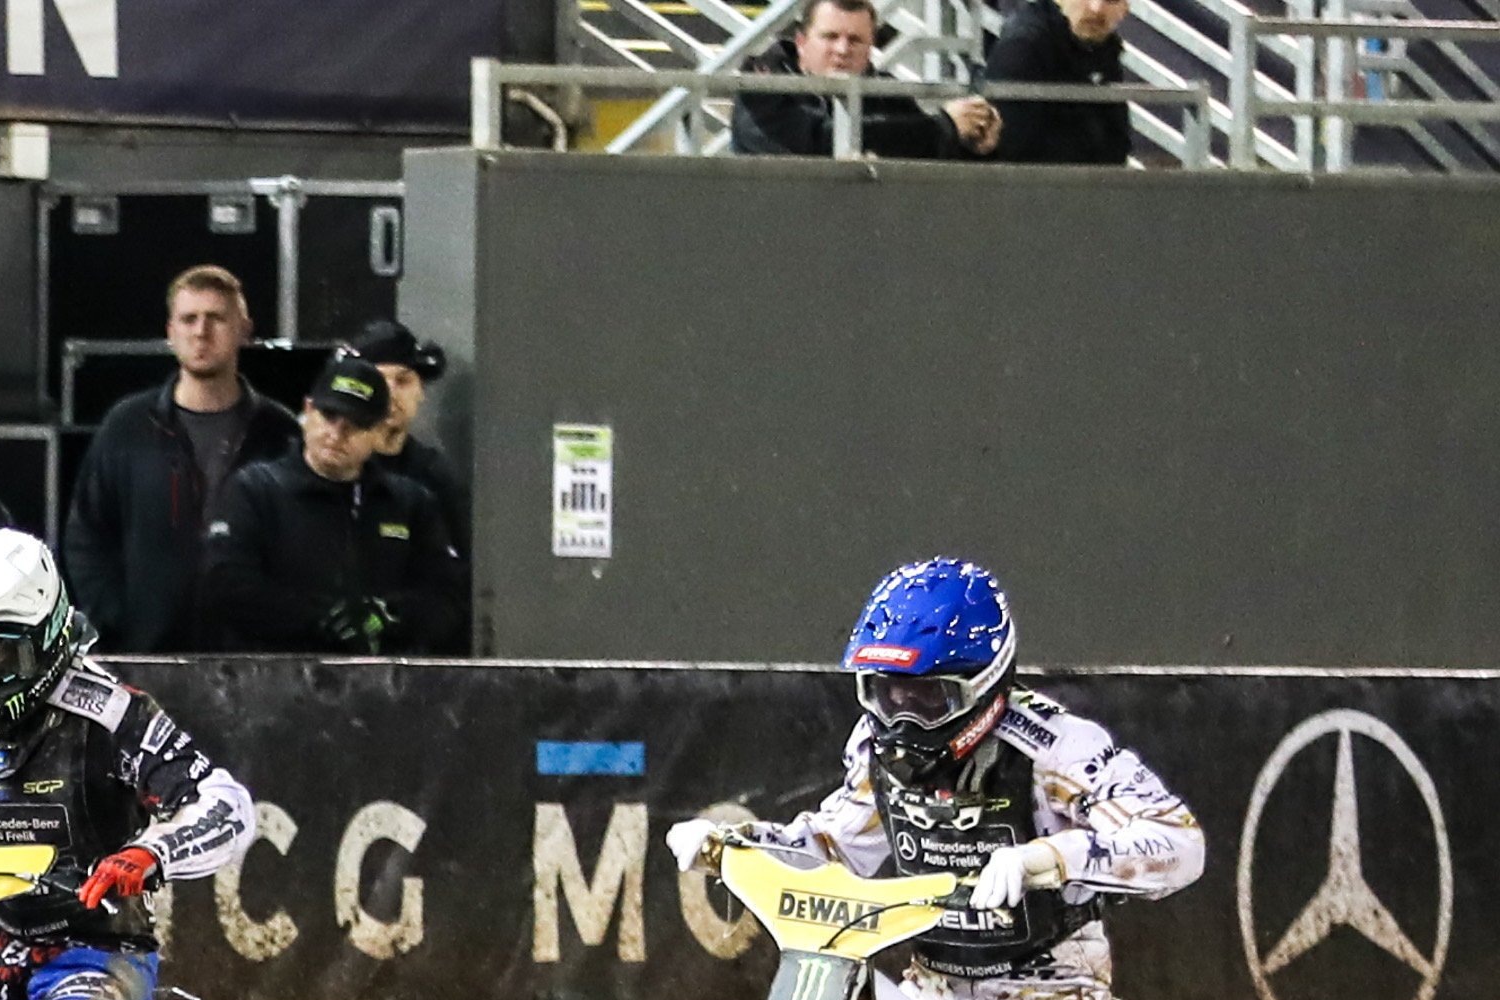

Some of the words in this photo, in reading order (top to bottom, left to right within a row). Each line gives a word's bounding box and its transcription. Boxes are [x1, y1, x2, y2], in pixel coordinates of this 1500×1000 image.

[23, 780, 64, 794] SGP
[5, 830, 37, 842] Frelik
[923, 855, 947, 867] Auto
[949, 856, 982, 868] Frelik
[155, 800, 425, 962] CG
[931, 961, 965, 975] ANDERS
[966, 962, 1013, 977] THOMSEN
